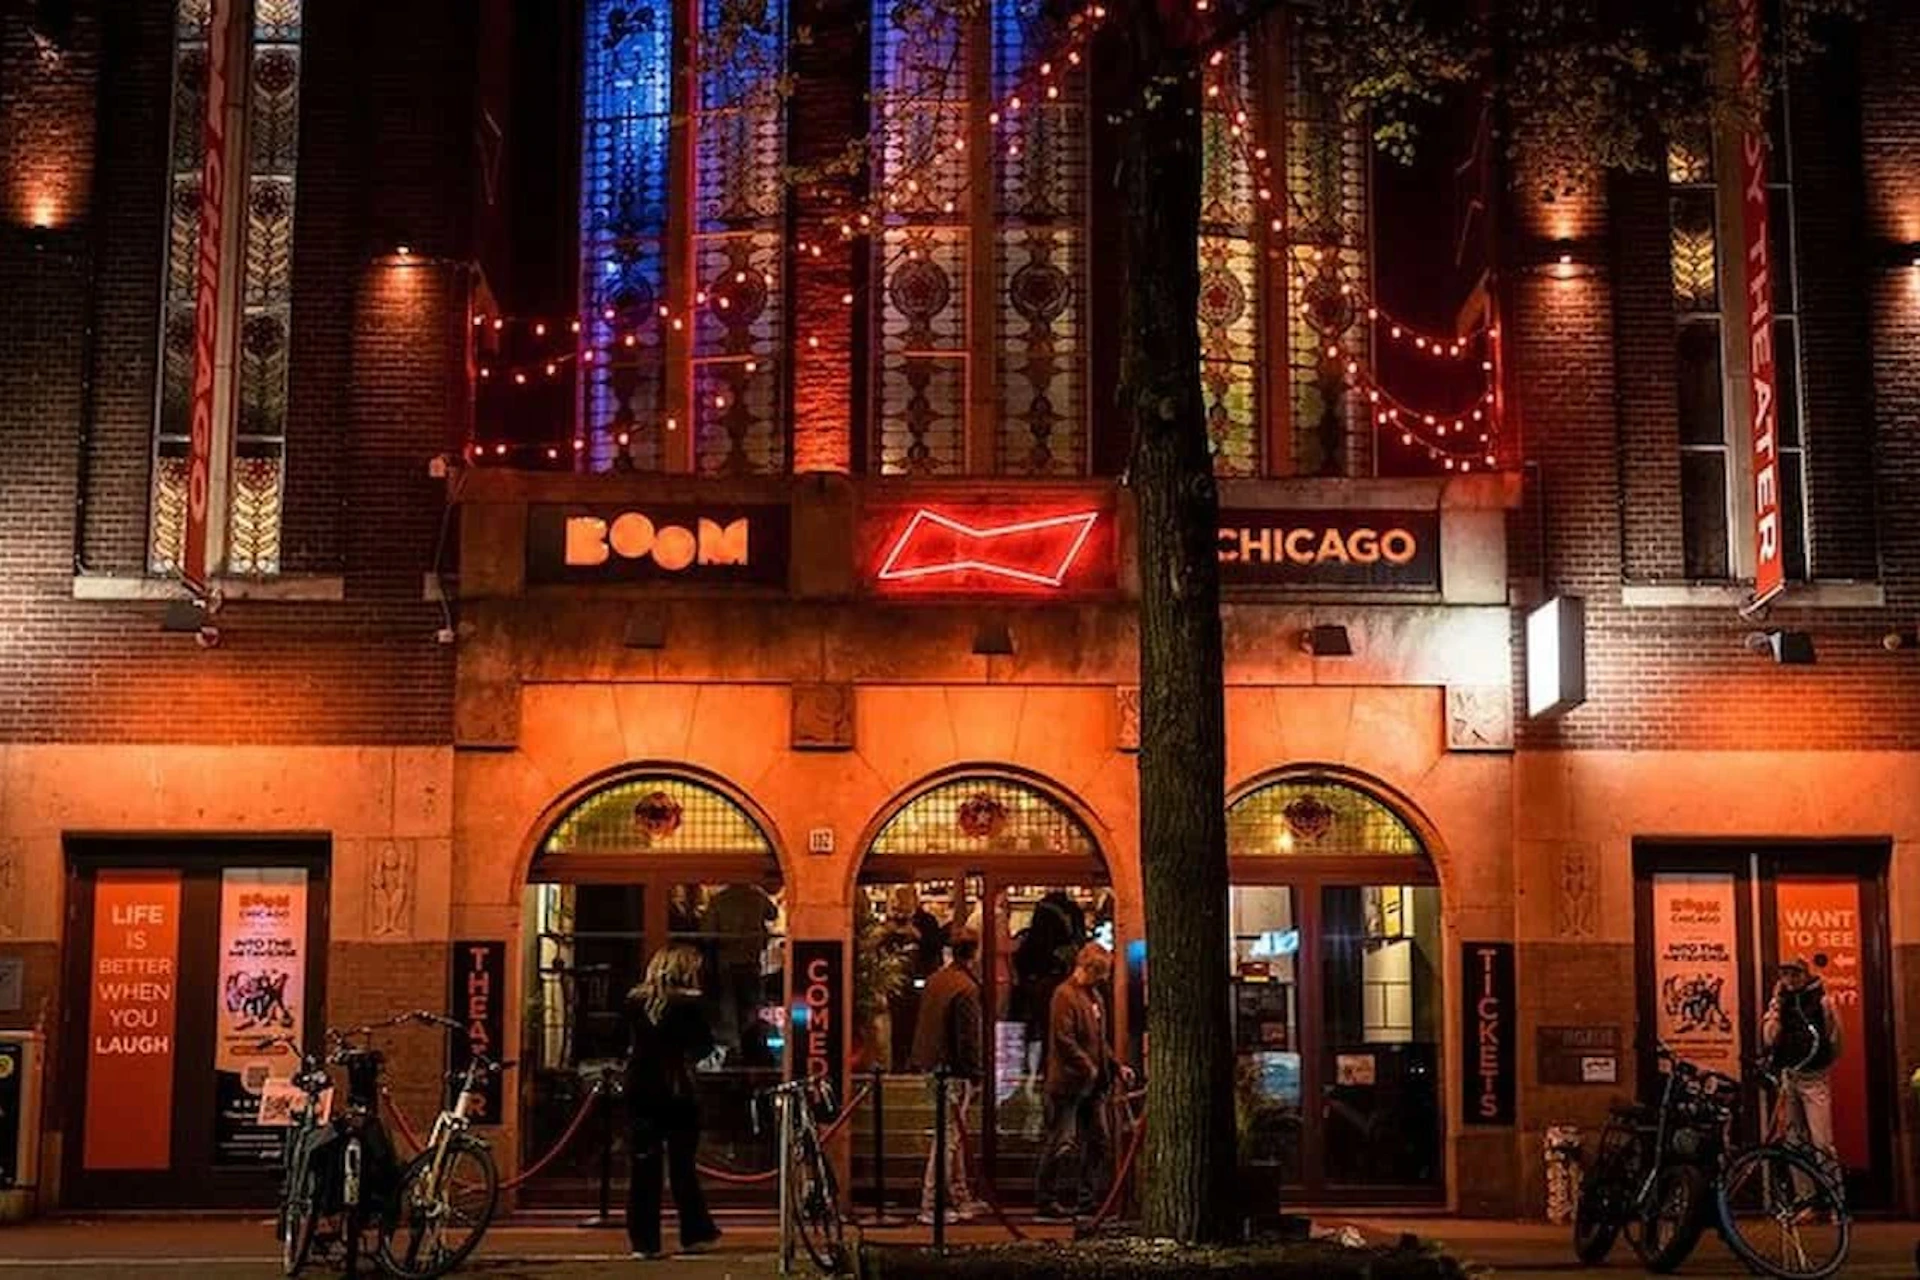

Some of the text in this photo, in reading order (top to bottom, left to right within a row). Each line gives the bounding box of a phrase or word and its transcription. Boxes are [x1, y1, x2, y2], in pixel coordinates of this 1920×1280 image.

[190, 149, 222, 521] CHICAGO
[1749, 221, 1777, 566] THEATER
[565, 512, 748, 571] BOOM
[111, 904, 164, 926] LIFE
[1784, 910, 1855, 928] WANT
[126, 930, 148, 950] IS
[1786, 931, 1854, 948] TO SEE
[99, 958, 172, 975] BETTER
[99, 983, 171, 1000] WHEN
[109, 1009, 158, 1028] YOU
[1477, 949, 1499, 1117] TICKETS
[96, 1036, 169, 1054] LAUGH
